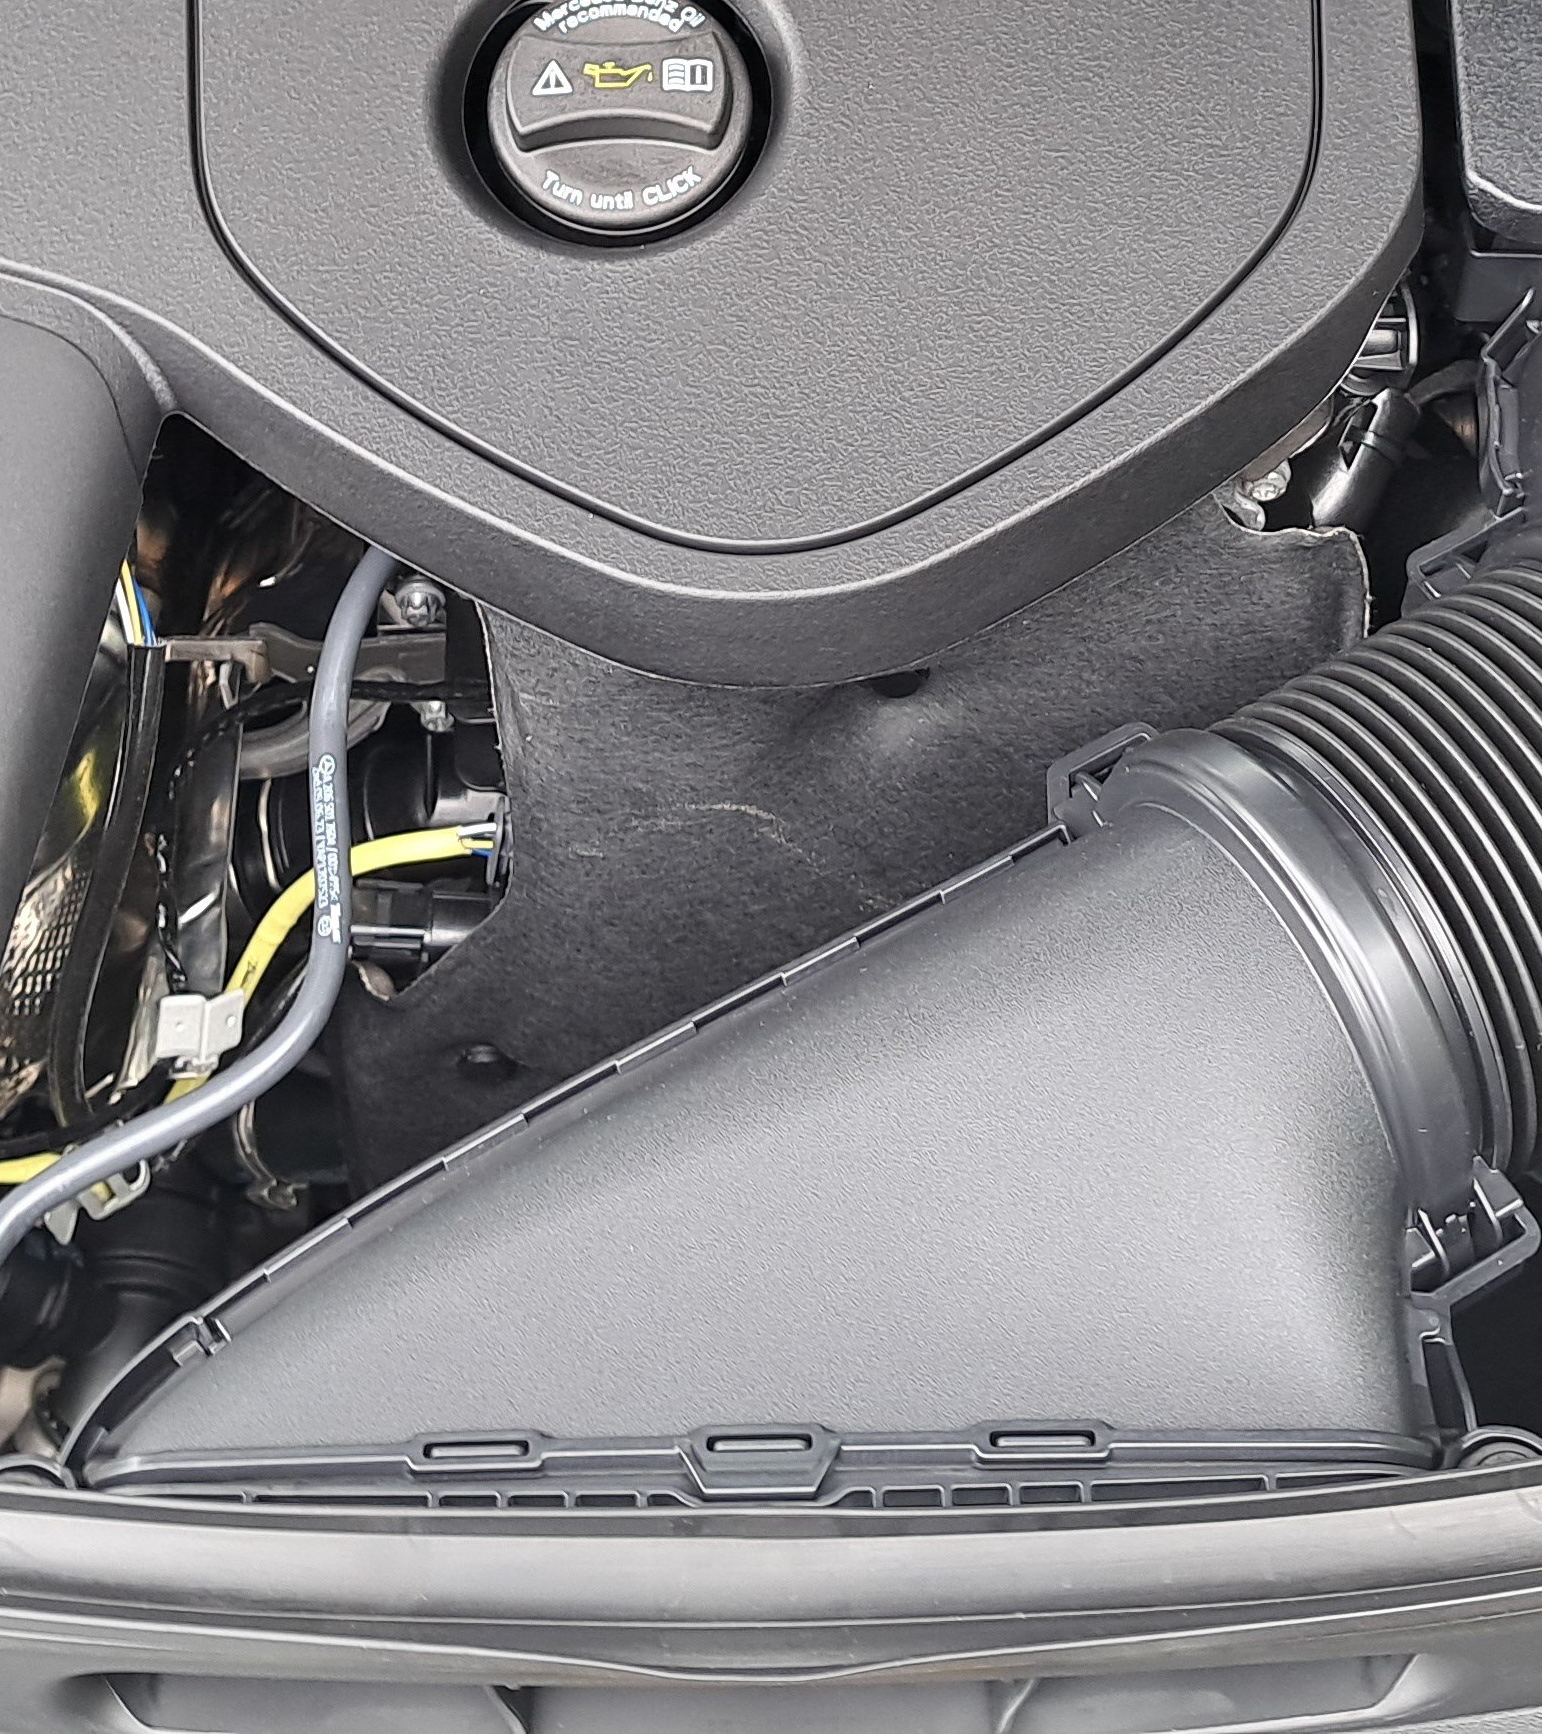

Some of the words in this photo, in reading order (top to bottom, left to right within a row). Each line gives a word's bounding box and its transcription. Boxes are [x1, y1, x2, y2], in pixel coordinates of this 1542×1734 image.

[560, 4, 685, 33] recommended
[680, 2, 706, 28] Oil
[542, 171, 583, 205] Turn
[590, 189, 634, 210] until
[643, 166, 702, 206] CLICK
